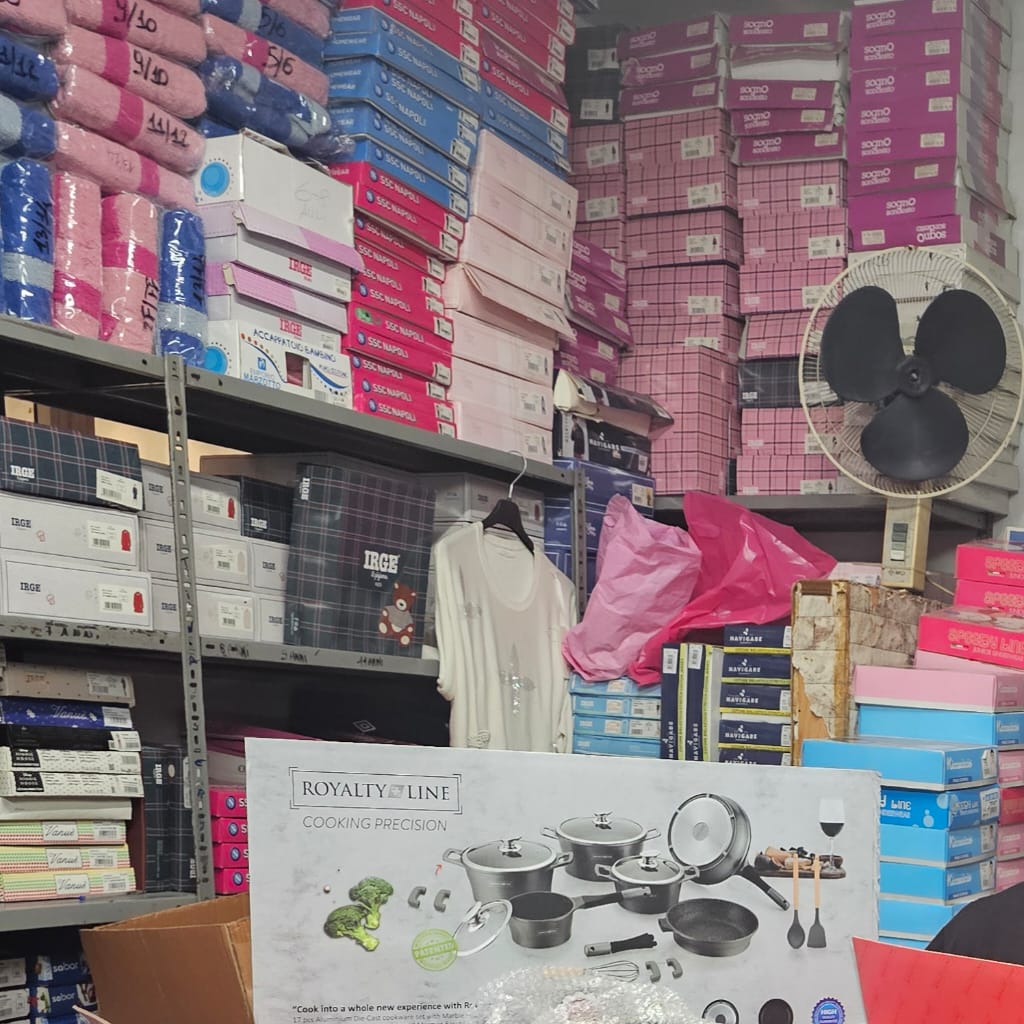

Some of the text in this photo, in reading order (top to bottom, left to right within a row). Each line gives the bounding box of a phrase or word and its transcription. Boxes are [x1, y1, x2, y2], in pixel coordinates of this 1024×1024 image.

[132, 48, 168, 86] 9/10
[263, 47, 297, 78] 5/6
[385, 91, 427, 127] SSC NAPOLI
[380, 176, 421, 204] SSC NAPOLI
[358, 244, 399, 270] SSC NAPOLI
[370, 289, 411, 313] SSC NAPOLI
[385, 320, 425, 343] SSC NAPOLI
[368, 337, 409, 359] SSC NAPOLI
[362, 360, 376, 372] SSC
[377, 363, 403, 380] NAPOLI
[372, 383, 413, 402] SSC NAPOLI
[378, 404, 416, 422] SSC NAPOLI
[10, 465, 35, 479] IRGE
[11, 517, 31, 529] IRGE
[250, 517, 268, 530] IRGE
[157, 543, 172, 552] IRGE
[363, 550, 399, 574] IRGE
[20, 582, 41, 593] IRGE
[161, 602, 177, 612] IRGE
[302, 781, 450, 800] ROYALTY LINE
[302, 816, 447, 832] COOKING PRECISION
[53, 961, 78, 973] sabor
[52, 991, 75, 1003] sabor
[397, 1003, 441, 1012] experience
